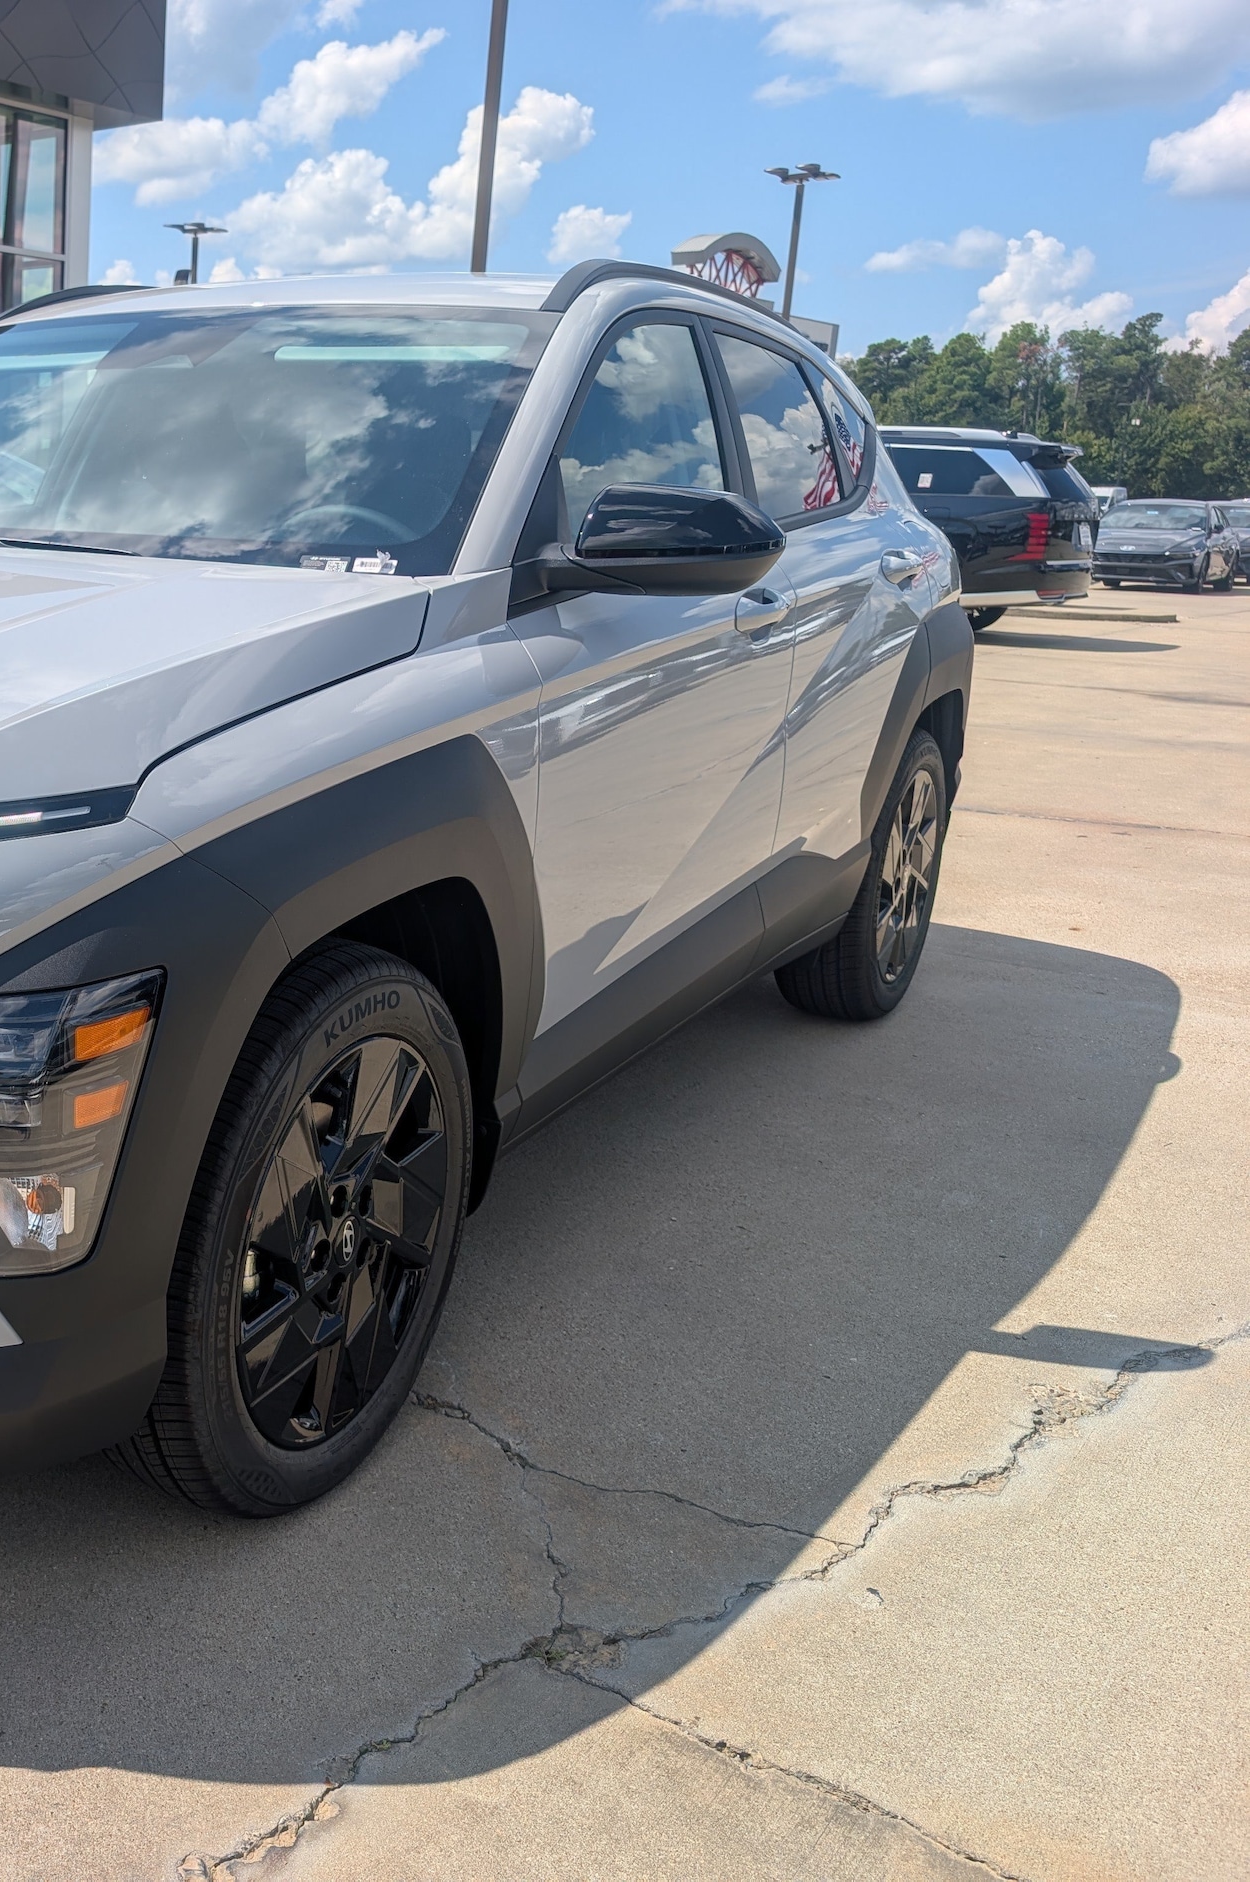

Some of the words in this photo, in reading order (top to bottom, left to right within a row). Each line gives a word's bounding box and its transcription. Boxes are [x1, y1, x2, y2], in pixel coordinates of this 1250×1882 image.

[323, 989, 401, 1049] KUMHO
[220, 1247, 235, 1298] 95V
[216, 1303, 229, 1349] R18
